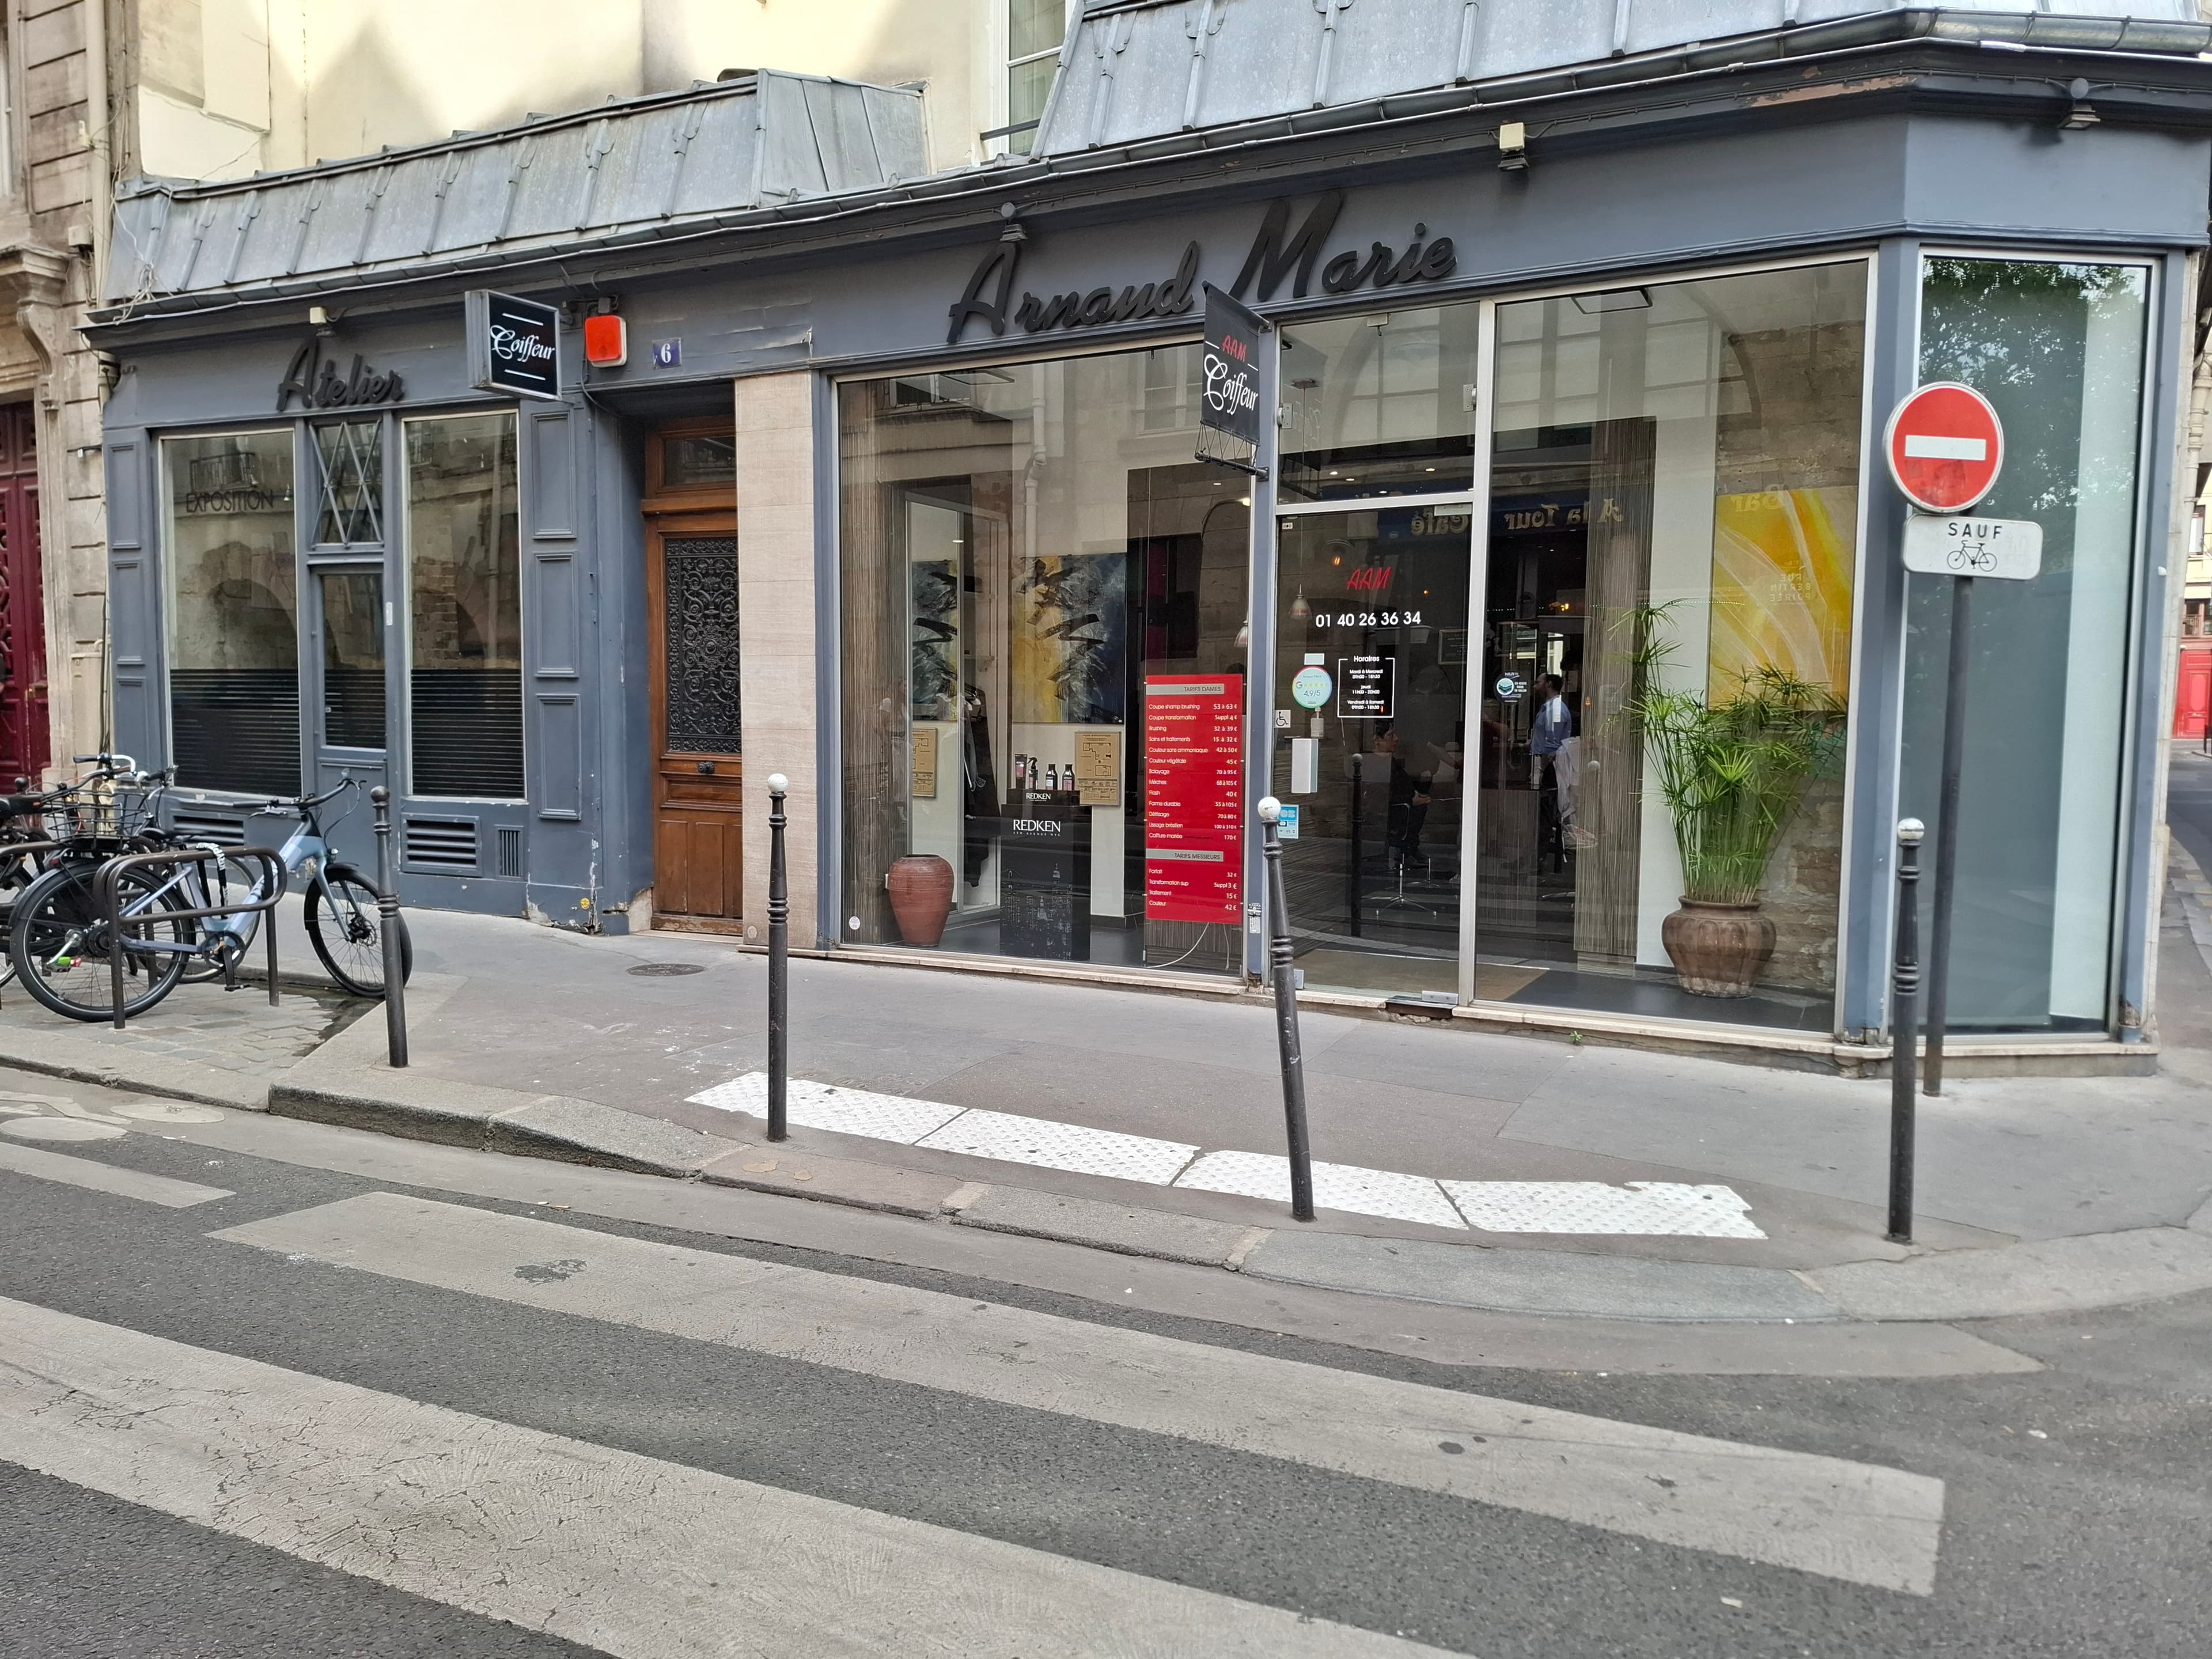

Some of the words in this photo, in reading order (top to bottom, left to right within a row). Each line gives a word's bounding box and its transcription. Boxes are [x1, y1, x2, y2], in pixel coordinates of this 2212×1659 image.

[946, 240, 1198, 344] Arnaud
[1230, 190, 1459, 303] Marie
[490, 324, 555, 362] Coiffeur
[660, 343, 672, 363] 6
[1222, 335, 1247, 363] AAM
[276, 336, 406, 412] Atelier
[1203, 354, 1259, 415] Coiffeur
[185, 489, 274, 513] EXPOSITION
[1948, 522, 2002, 539] SAUF
[1346, 567, 1392, 590] AAM
[1316, 614, 1331, 627] 01
[1337, 613, 1354, 627] 40
[1359, 613, 1376, 626] 26
[1381, 612, 1399, 625] 36
[1403, 611, 1421, 624] 34
[1013, 819, 1060, 832] REDKEN
